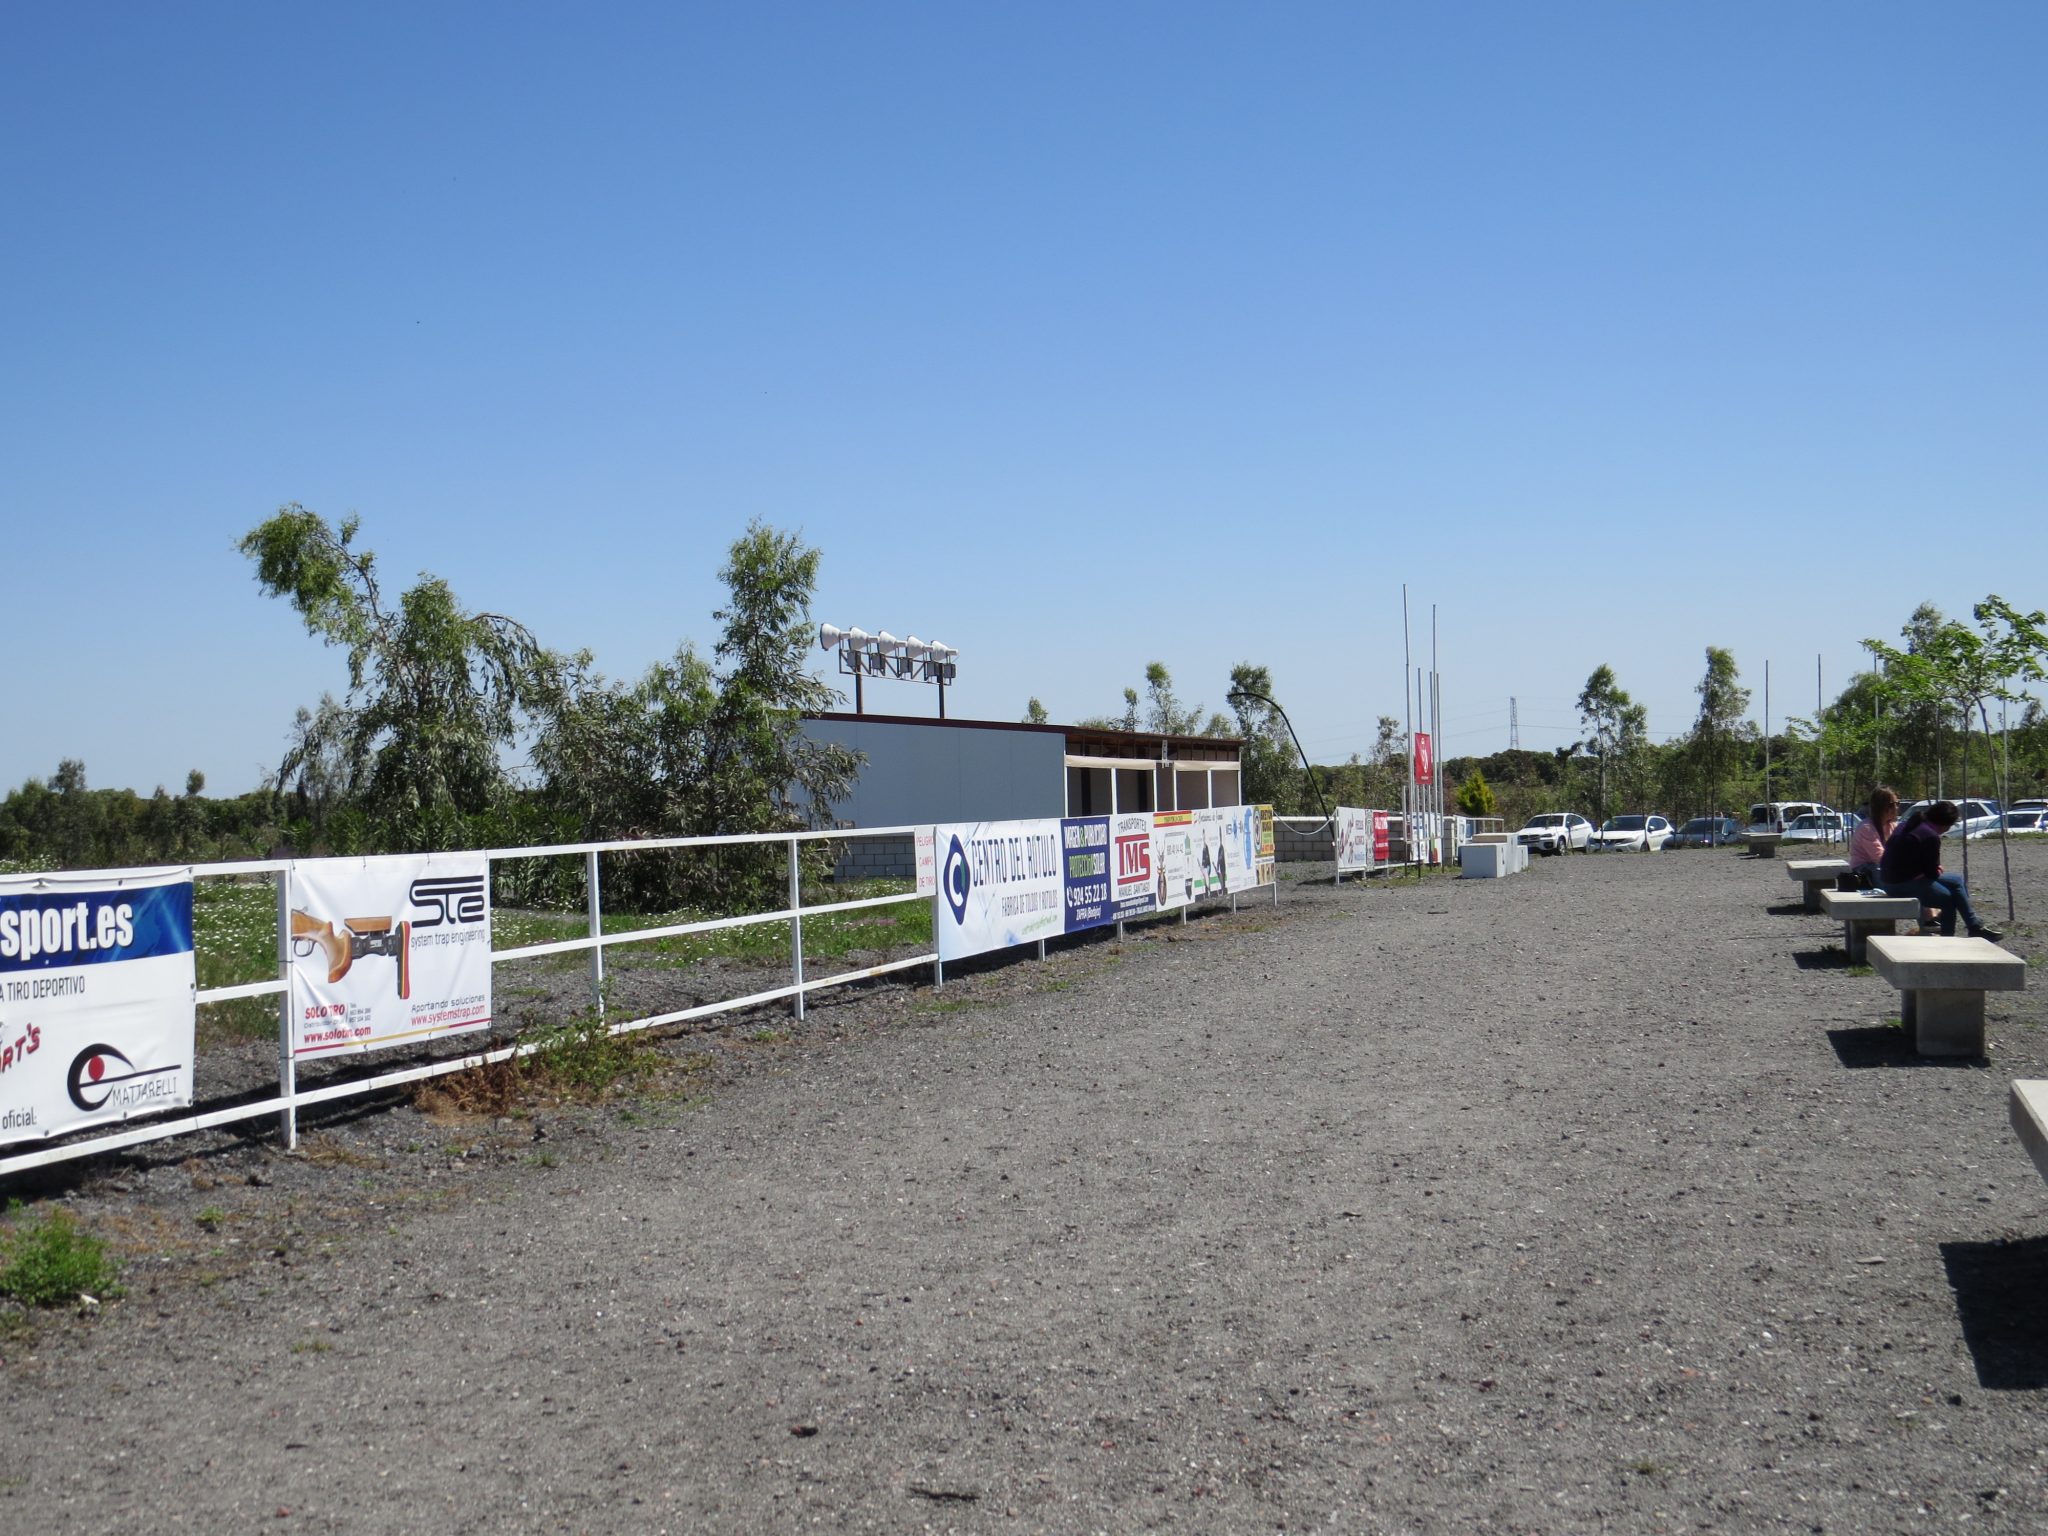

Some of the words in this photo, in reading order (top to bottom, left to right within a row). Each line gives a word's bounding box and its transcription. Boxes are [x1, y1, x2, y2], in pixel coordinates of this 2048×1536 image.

[918, 856, 933, 867] CAMPO
[971, 837, 1007, 888] CENTRO
[1008, 836, 1026, 882] DEL
[1115, 833, 1151, 886] TMS
[1074, 887, 1084, 906] 924
[1085, 885, 1092, 904] 55
[1093, 884, 1100, 902] 22
[1101, 882, 1107, 900] 18
[411, 932, 434, 950] system
[435, 931, 450, 947] trap
[451, 928, 485, 945] engineering
[7, 980, 30, 1002] TIRO
[33, 975, 85, 1000] DEPORTIVO
[305, 1004, 345, 1019] SOLOTRO
[411, 1000, 448, 1013] Aportando
[451, 994, 485, 1007] soluciones
[411, 1005, 485, 1026] www.systemstrap.com
[112, 1076, 177, 1107] MATTARELLI
